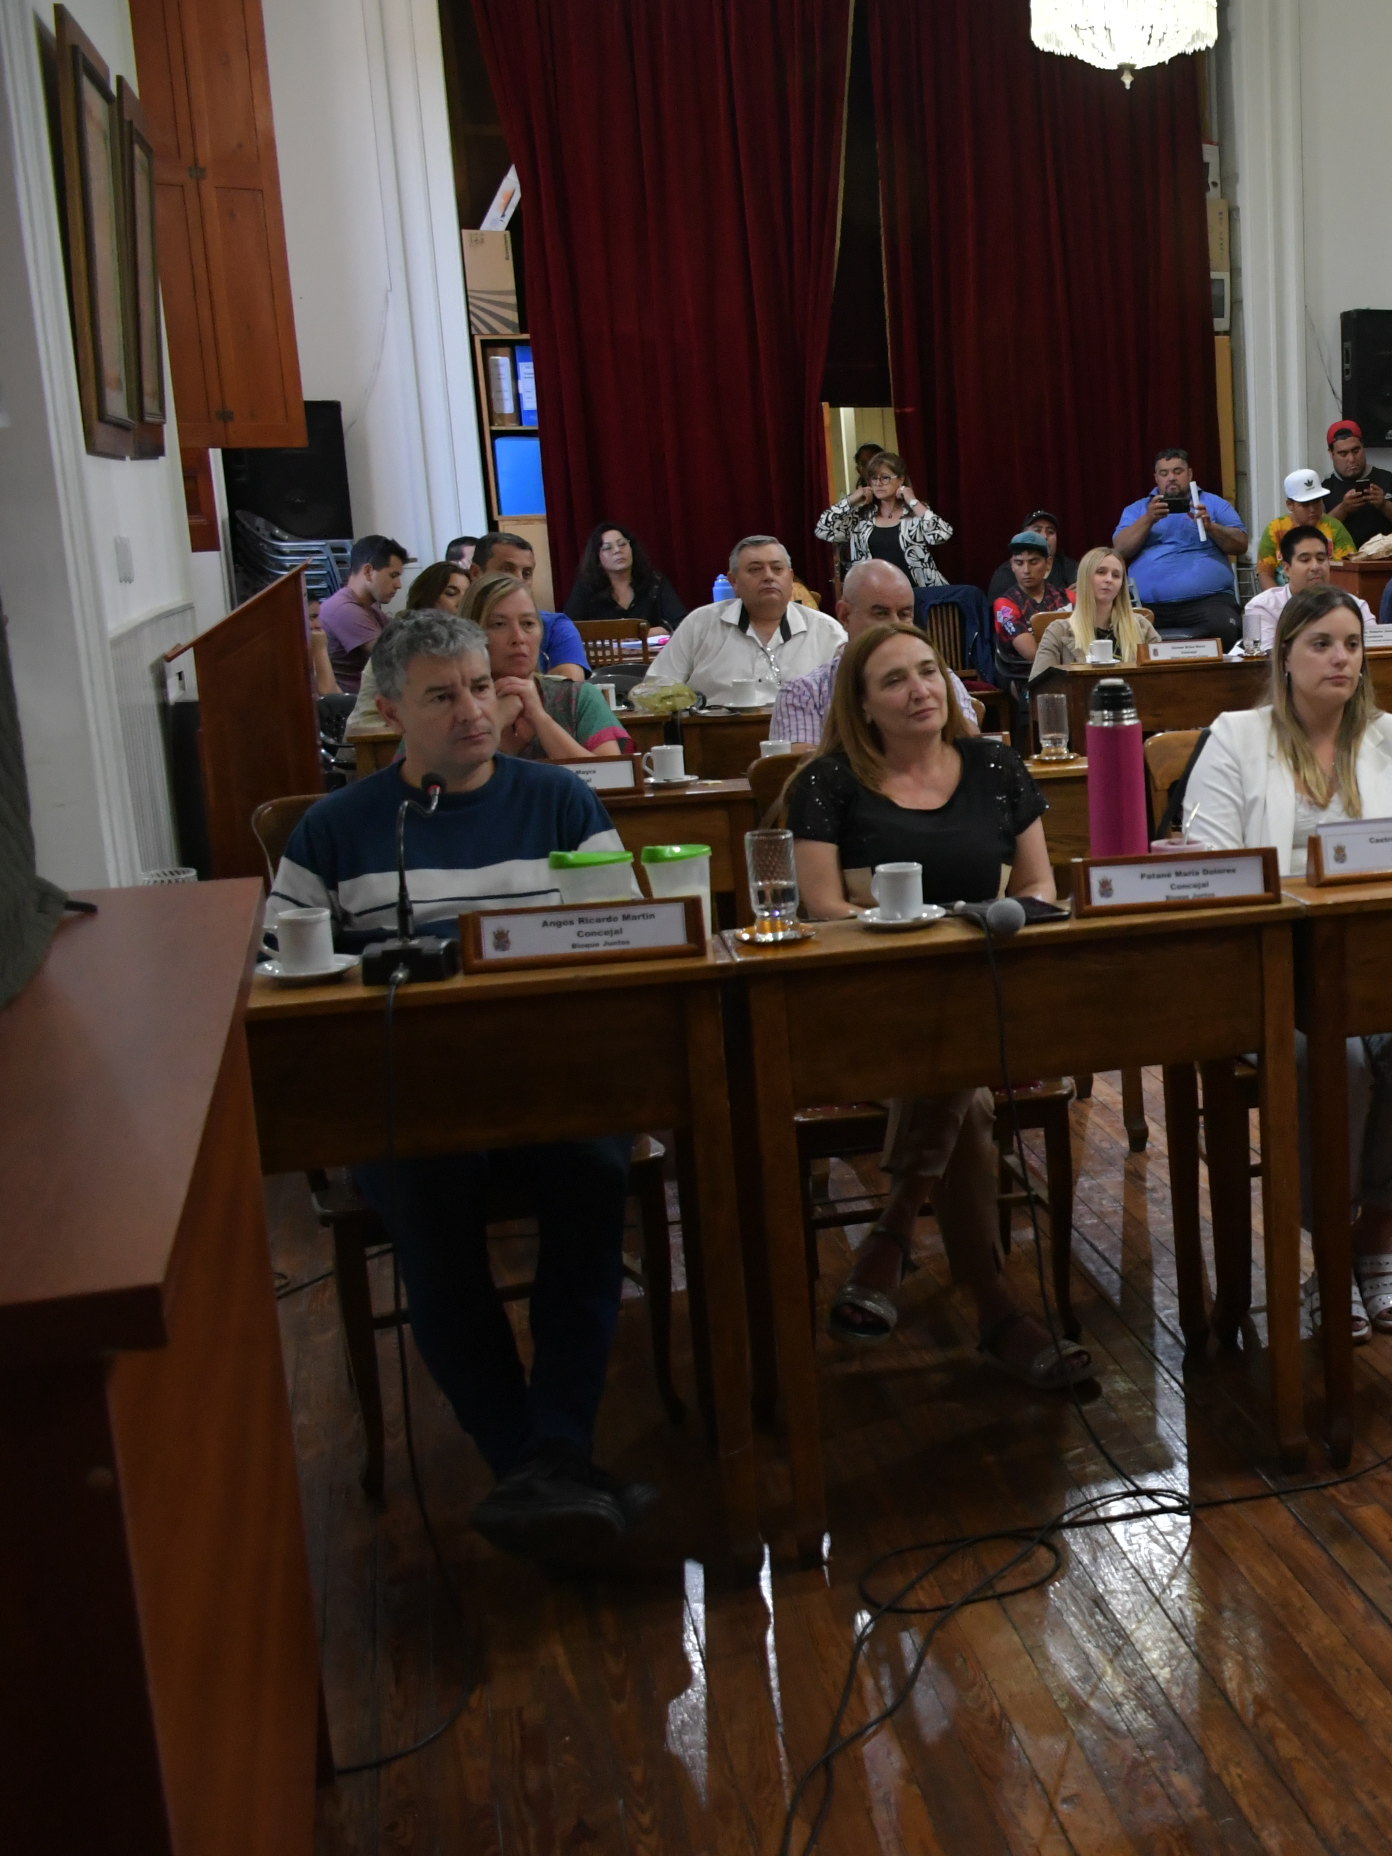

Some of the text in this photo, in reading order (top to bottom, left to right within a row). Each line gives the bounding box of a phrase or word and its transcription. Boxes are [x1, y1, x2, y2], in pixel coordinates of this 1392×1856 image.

[1202, 867, 1237, 876] Dolores
[1169, 880, 1210, 891] Concejal
[541, 919, 575, 929] Angos
[577, 914, 619, 926] Ricardo
[576, 927, 623, 939] Concejal
[571, 939, 631, 950] Bloque Juntos
